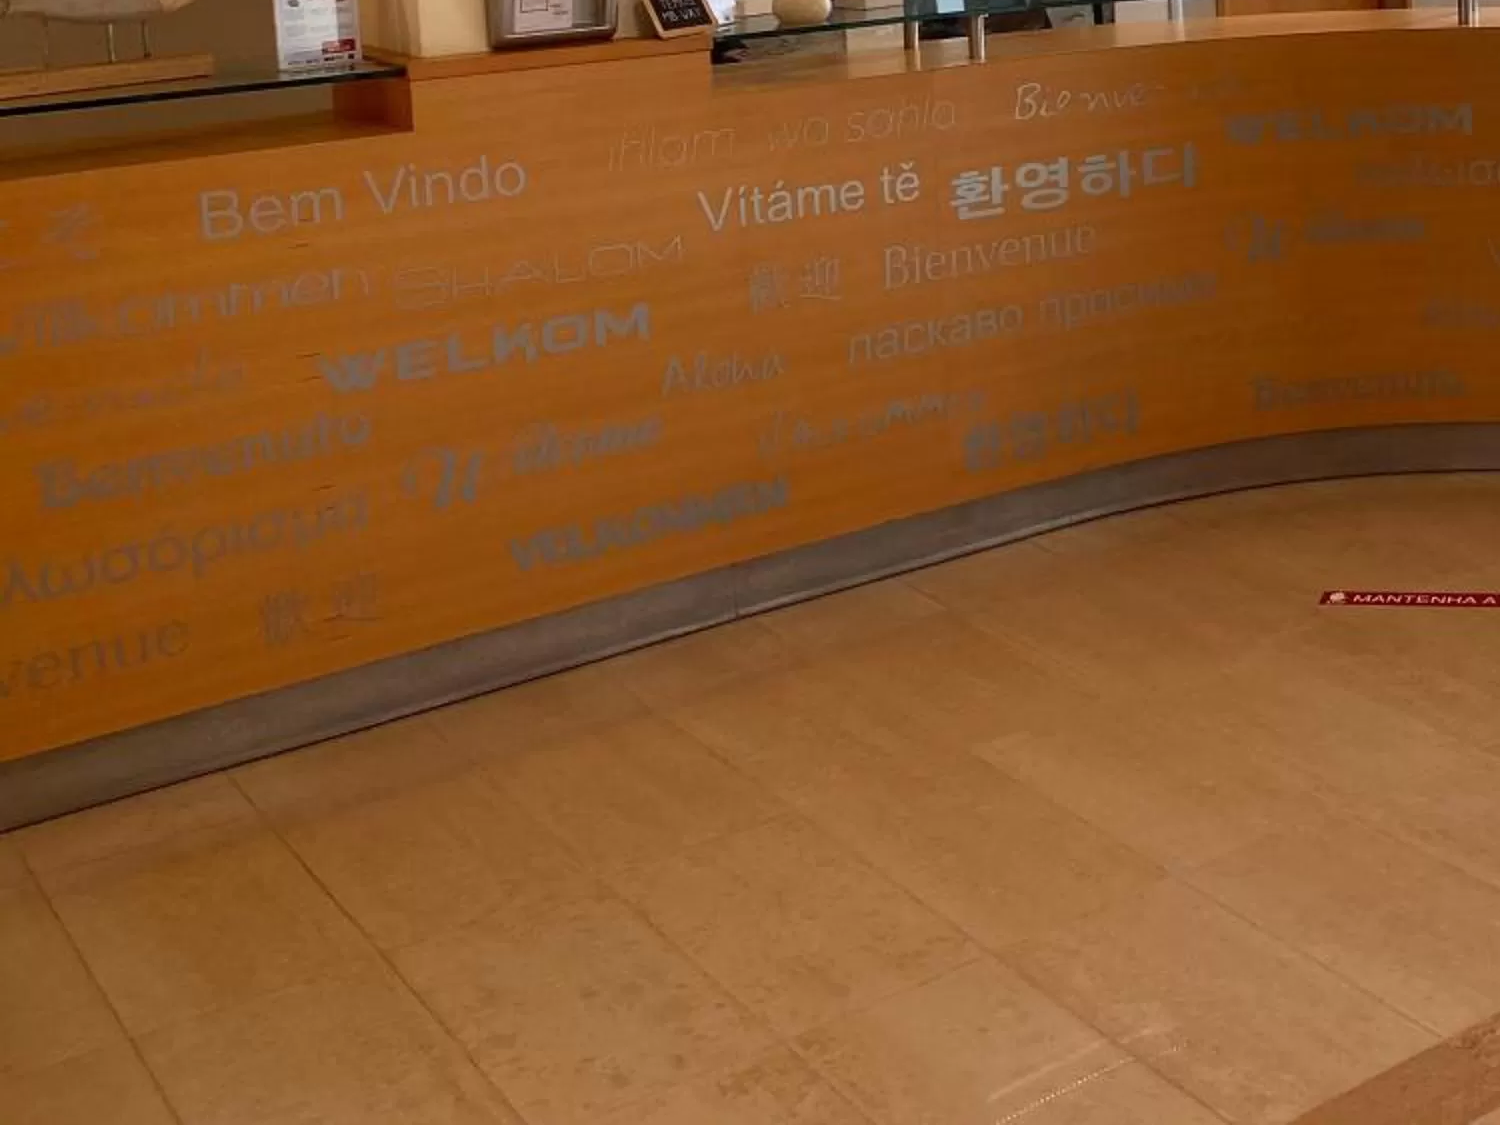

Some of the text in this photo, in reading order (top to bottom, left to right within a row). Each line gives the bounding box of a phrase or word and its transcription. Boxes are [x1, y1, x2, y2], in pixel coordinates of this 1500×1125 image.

[200, 153, 528, 243] Bem Vindo
[697, 160, 921, 233] Vítáme tě
[950, 140, 1198, 220] 환영하다
[882, 220, 1098, 292] Bienvenue
[319, 301, 652, 394] WELKOM
[1352, 593, 1477, 605] MANTENHA
[1482, 595, 1497, 605] A
